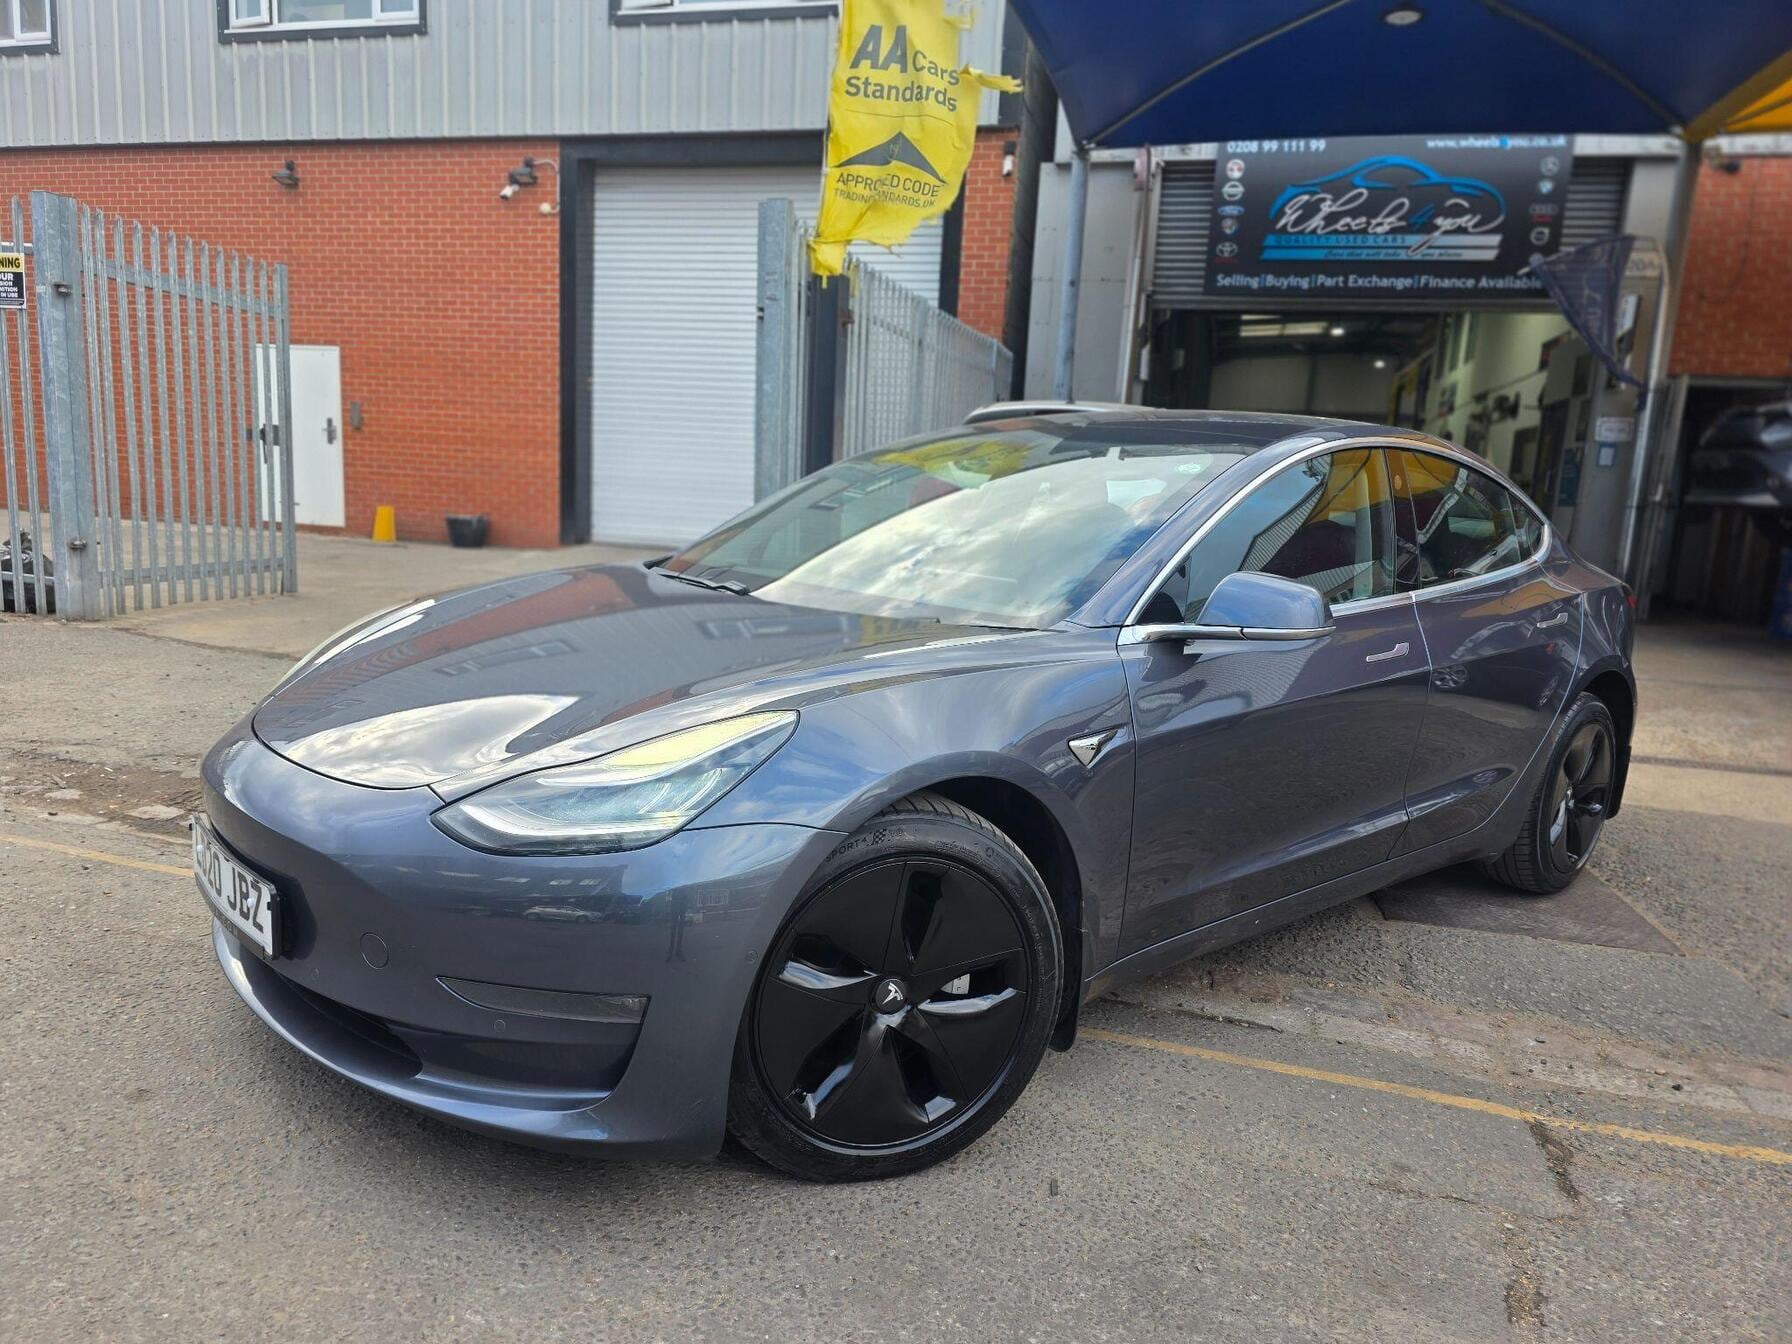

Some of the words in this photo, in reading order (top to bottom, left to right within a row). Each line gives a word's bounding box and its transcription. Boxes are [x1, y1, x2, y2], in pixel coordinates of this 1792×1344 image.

[849, 24, 908, 73] AA
[912, 49, 960, 86] Cars
[845, 75, 957, 112] Standards
[1227, 140, 1259, 153] 0208
[1262, 140, 1279, 153] 99
[1282, 140, 1305, 153] 111
[1309, 139, 1326, 152] 99
[902, 177, 940, 198] CODE
[1276, 188, 1410, 235] Wheels
[1408, 203, 1436, 231] 4
[1274, 236, 1331, 245] QUALITY
[1335, 236, 1371, 245] USED
[1374, 236, 1407, 245] CARS
[1408, 199, 1505, 257] you
[1216, 274, 1259, 289] Selling
[1265, 275, 1310, 289] Buying
[1317, 274, 1344, 288] Part
[1349, 274, 1413, 290] Exchange
[1420, 275, 1475, 288] Finance
[1478, 275, 1542, 289] Available
[825, 838, 860, 863] SPORT
[227, 866, 265, 935] JBZ
